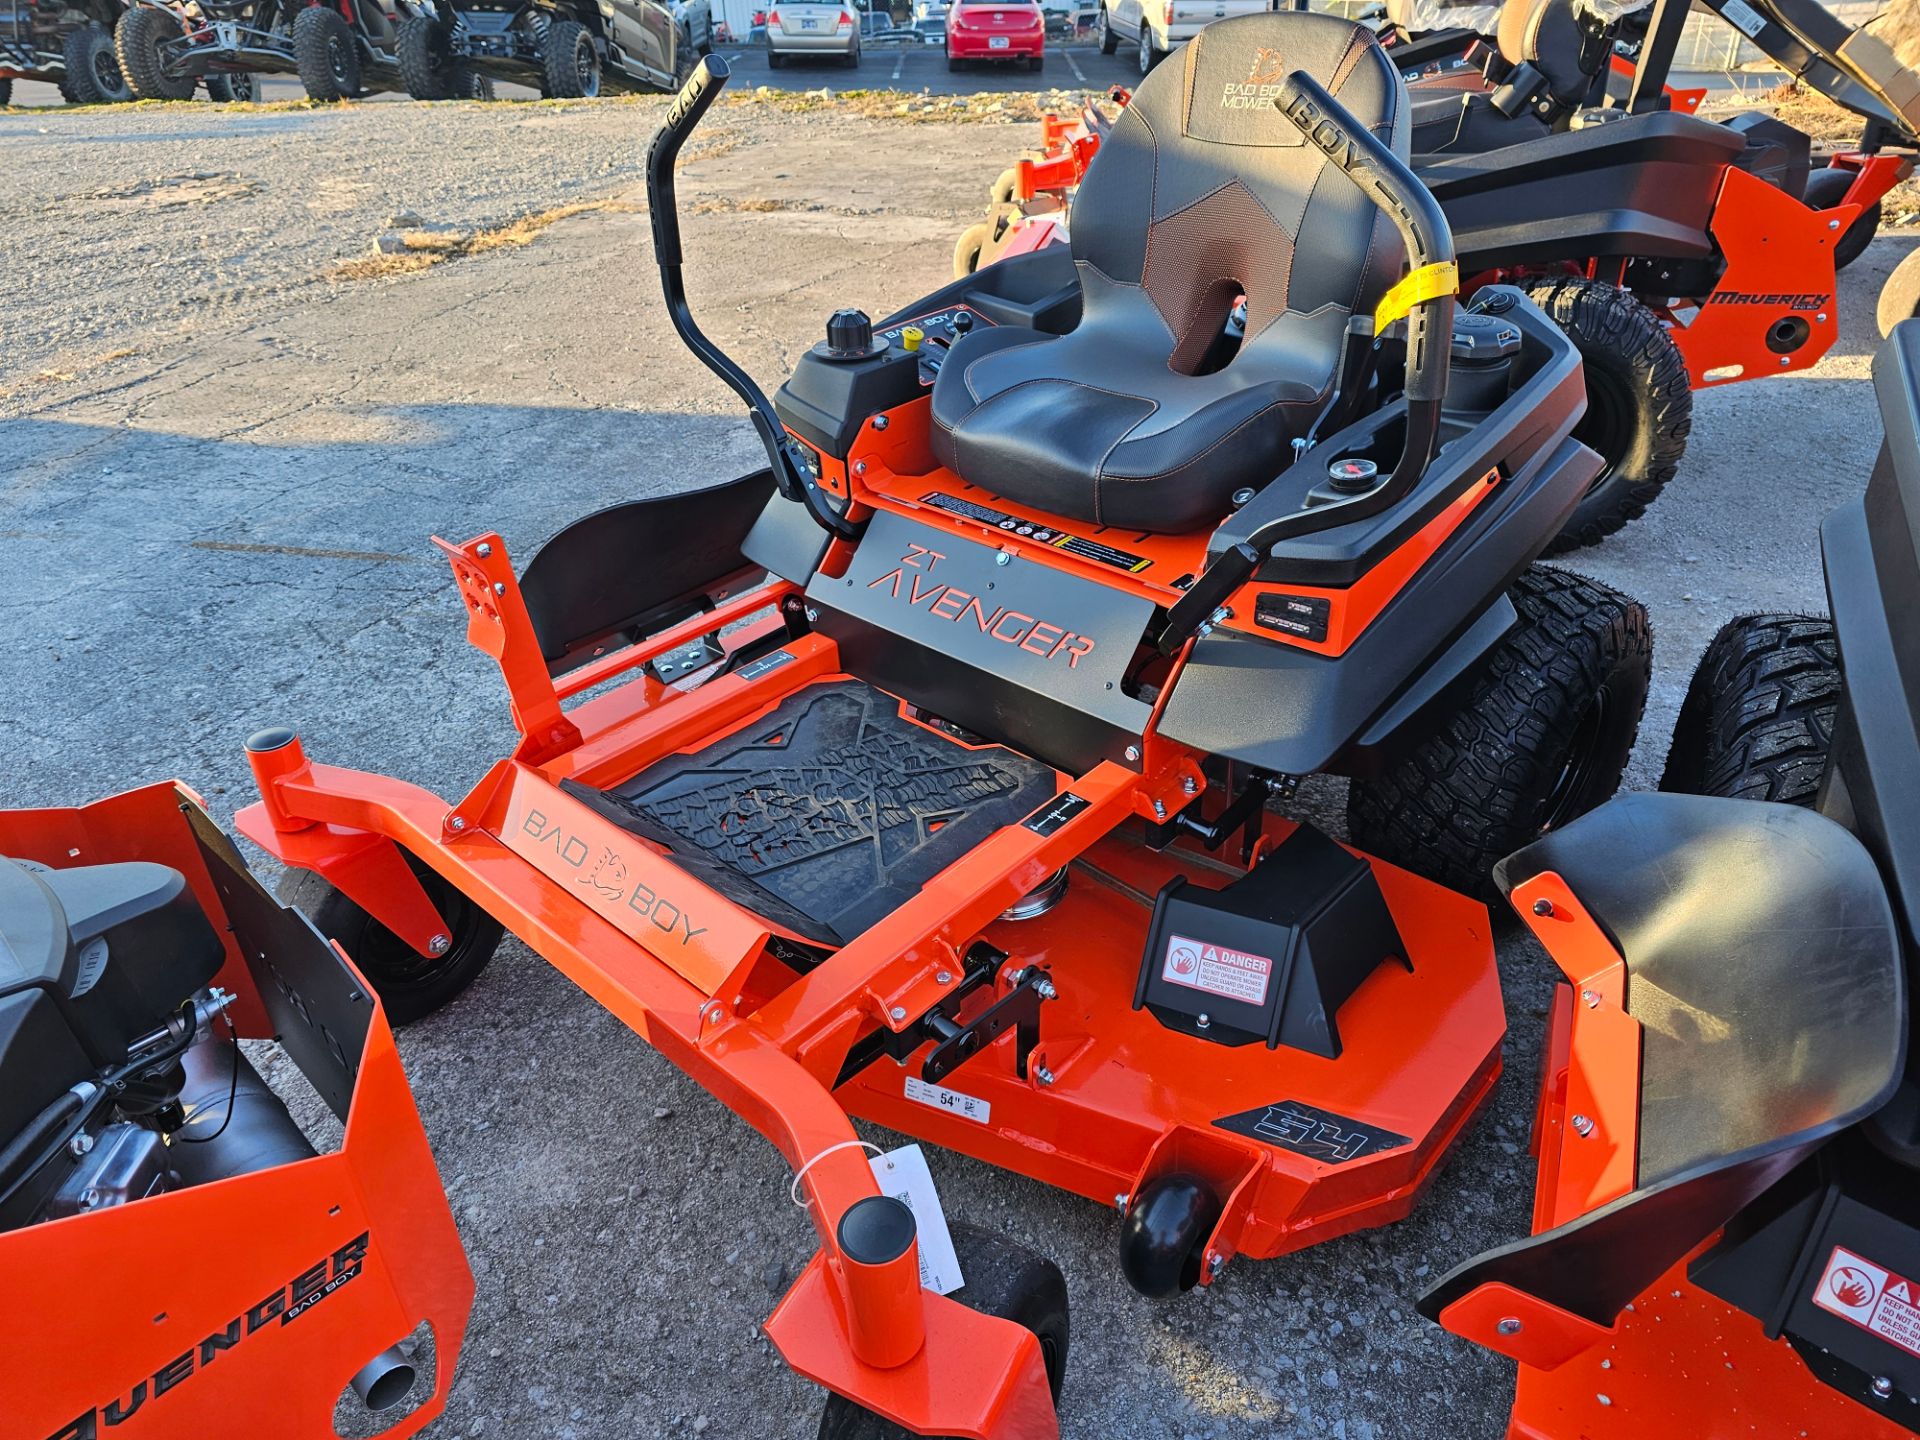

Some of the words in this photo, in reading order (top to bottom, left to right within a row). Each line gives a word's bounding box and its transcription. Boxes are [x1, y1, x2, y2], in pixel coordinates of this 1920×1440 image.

[1224, 83, 1256, 96] BAD
[1260, 85, 1280, 96] BO
[1221, 95, 1276, 110] MOWER
[1286, 94, 1378, 172] BOY
[1710, 292, 1831, 304] MAVERICK
[924, 313, 950, 326] BOY
[901, 543, 946, 571] ZT
[867, 567, 1096, 668] AVENGER
[523, 809, 589, 867] BAD
[628, 883, 708, 946] BOY
[1222, 952, 1267, 972] DANGER
[1200, 973, 1218, 983] UNLESS
[1203, 981, 1224, 991] CATCHER
[1221, 973, 1242, 982] OPERATE
[1243, 978, 1262, 986] MOWER
[1254, 1106, 1368, 1160] 54
[289, 1292, 321, 1318] BAD
[325, 1267, 355, 1292] BOY
[1884, 1297, 1904, 1310] KEEP
[1878, 1314, 1909, 1333] UNLESS
[1883, 1306, 1895, 1317] DO
[1896, 1312, 1912, 1325] NOT
[1880, 1325, 1916, 1347] CATCHER
